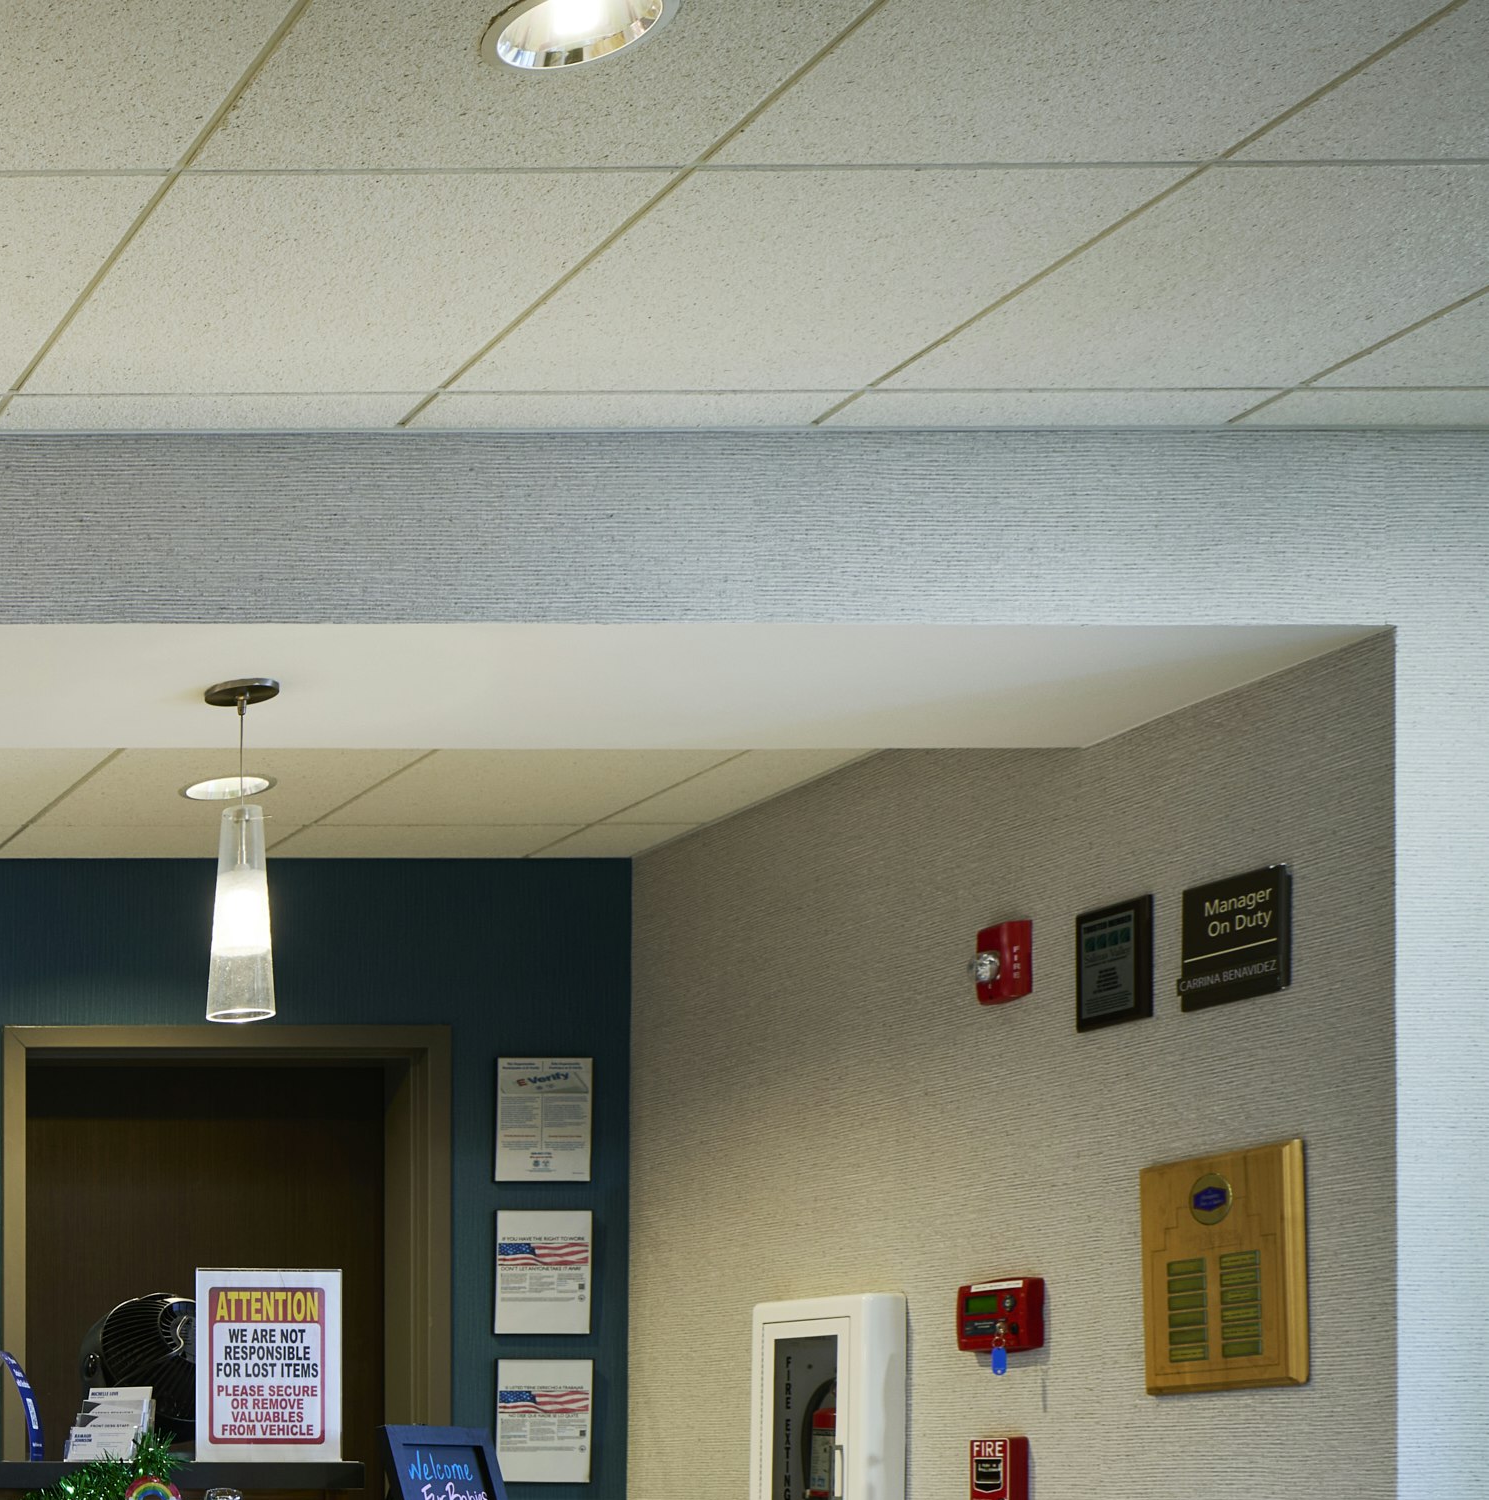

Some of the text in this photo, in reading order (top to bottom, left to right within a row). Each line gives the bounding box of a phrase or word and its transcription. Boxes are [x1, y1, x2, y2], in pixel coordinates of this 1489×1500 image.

[1204, 888, 1273, 917] Manager
[1208, 910, 1272, 937] On Duty
[1013, 945, 1021, 979] FIRE
[1179, 959, 1277, 992] CARRINA BENAVIDEZ
[216, 1291, 318, 1321] ATTENTION
[229, 1329, 306, 1344] WE ARE NOT
[224, 1346, 311, 1361] RESPONSIBLE
[216, 1363, 319, 1378] FOR LOST ITEMS
[217, 1385, 318, 1397] PLEASE SECURE
[784, 1356, 792, 1410] FIRE
[231, 1398, 304, 1410] OR REMOVE
[232, 1411, 304, 1423] VALUABLES
[222, 1424, 313, 1436] FROM VEHICLE
[973, 1441, 1004, 1457] FIRE
[409, 1450, 473, 1482] Welcome
